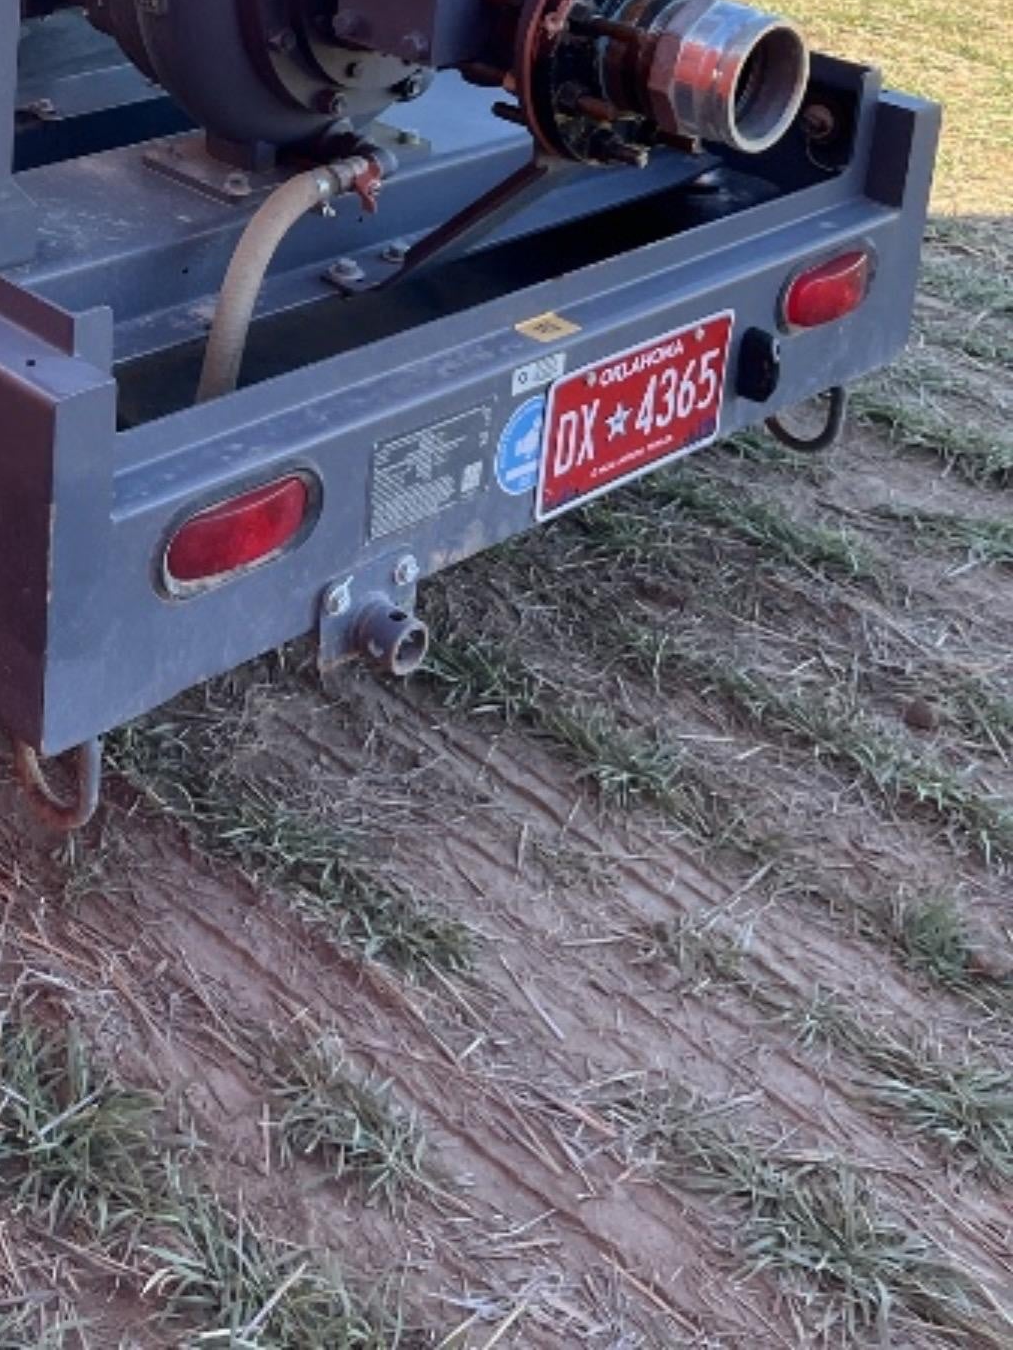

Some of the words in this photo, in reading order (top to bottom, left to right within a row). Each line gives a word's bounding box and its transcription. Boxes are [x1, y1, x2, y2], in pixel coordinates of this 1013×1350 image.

[598, 338, 685, 387] OKLAHOMA
[553, 398, 601, 479] DX
[634, 347, 721, 436] 4365
